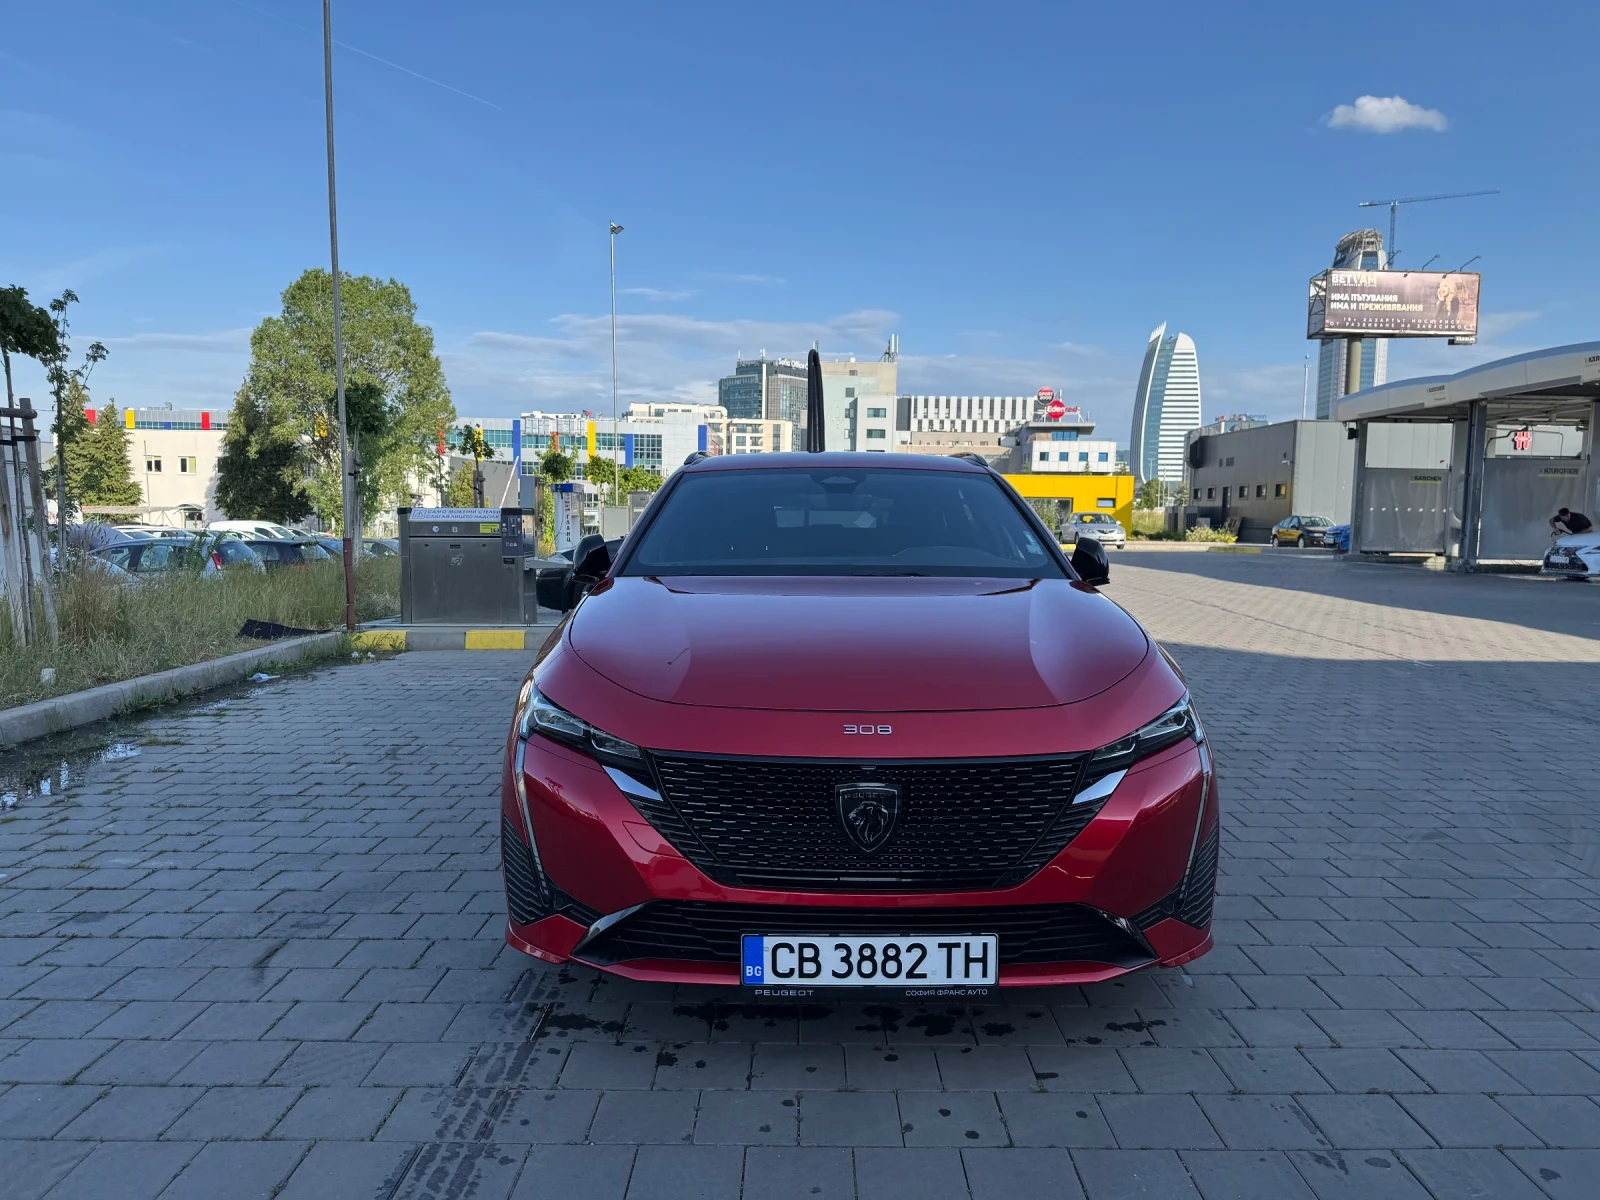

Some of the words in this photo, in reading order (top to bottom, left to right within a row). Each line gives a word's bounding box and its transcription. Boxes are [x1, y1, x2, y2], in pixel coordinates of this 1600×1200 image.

[1330, 293, 1350, 302] ИМА
[1351, 294, 1398, 302] ПЪТУВАНИЯ
[1330, 302, 1349, 310] ИМА
[1358, 303, 1424, 312] ПРЕЖИВЯВАНИЯ
[842, 724, 892, 735] 308
[746, 966, 762, 976] BG
[771, 942, 822, 979] CB
[831, 942, 928, 979] 3882
[937, 942, 988, 979] TH
[936, 988, 966, 996] ФРАНС
[967, 988, 988, 996] АУТО
